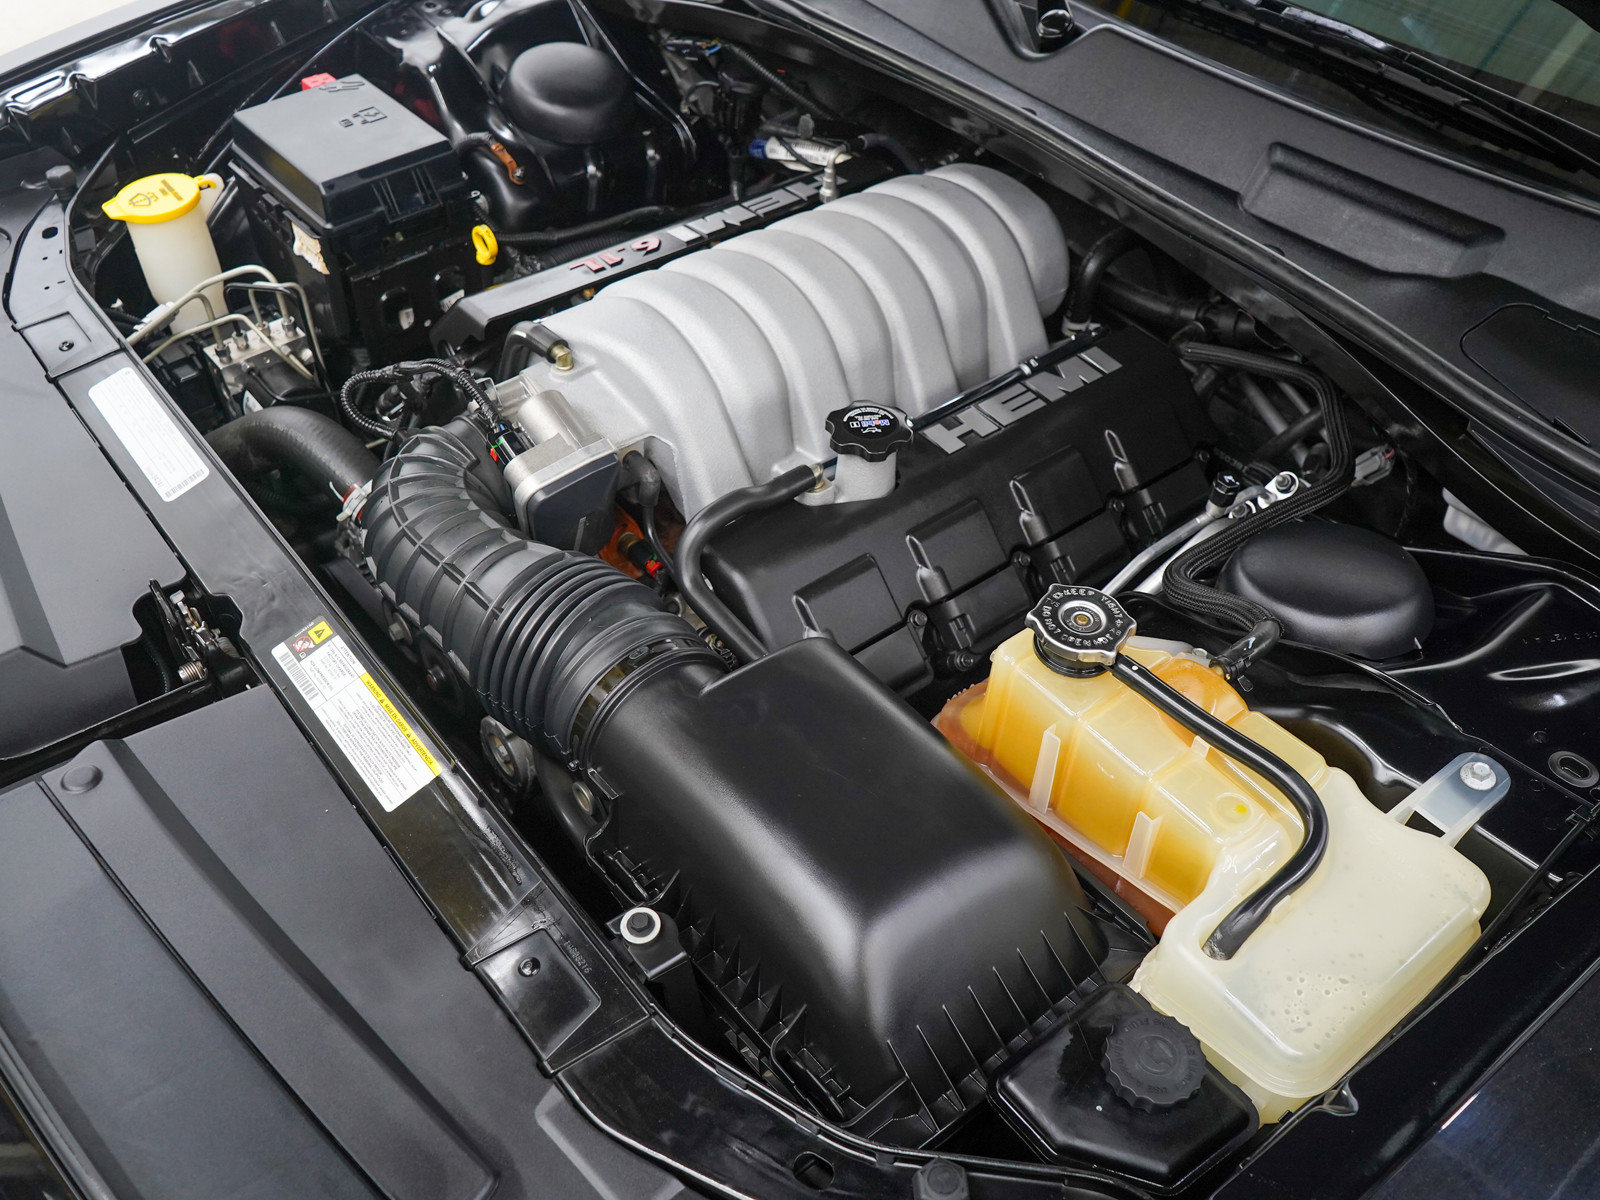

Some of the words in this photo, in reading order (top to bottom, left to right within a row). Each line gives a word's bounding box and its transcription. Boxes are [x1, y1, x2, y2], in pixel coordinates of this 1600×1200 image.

[667, 173, 847, 242] HEMI
[568, 235, 661, 273] 6.1L
[861, 419, 890, 428] Mobil
[920, 346, 1123, 454] HEMI
[1101, 595, 1124, 620] TIGHT
[364, 679, 382, 699] WARNING
[382, 702, 394, 715] MISE
[394, 717, 408, 733] GARDE
[409, 736, 434, 766] ADVERTENCIA
